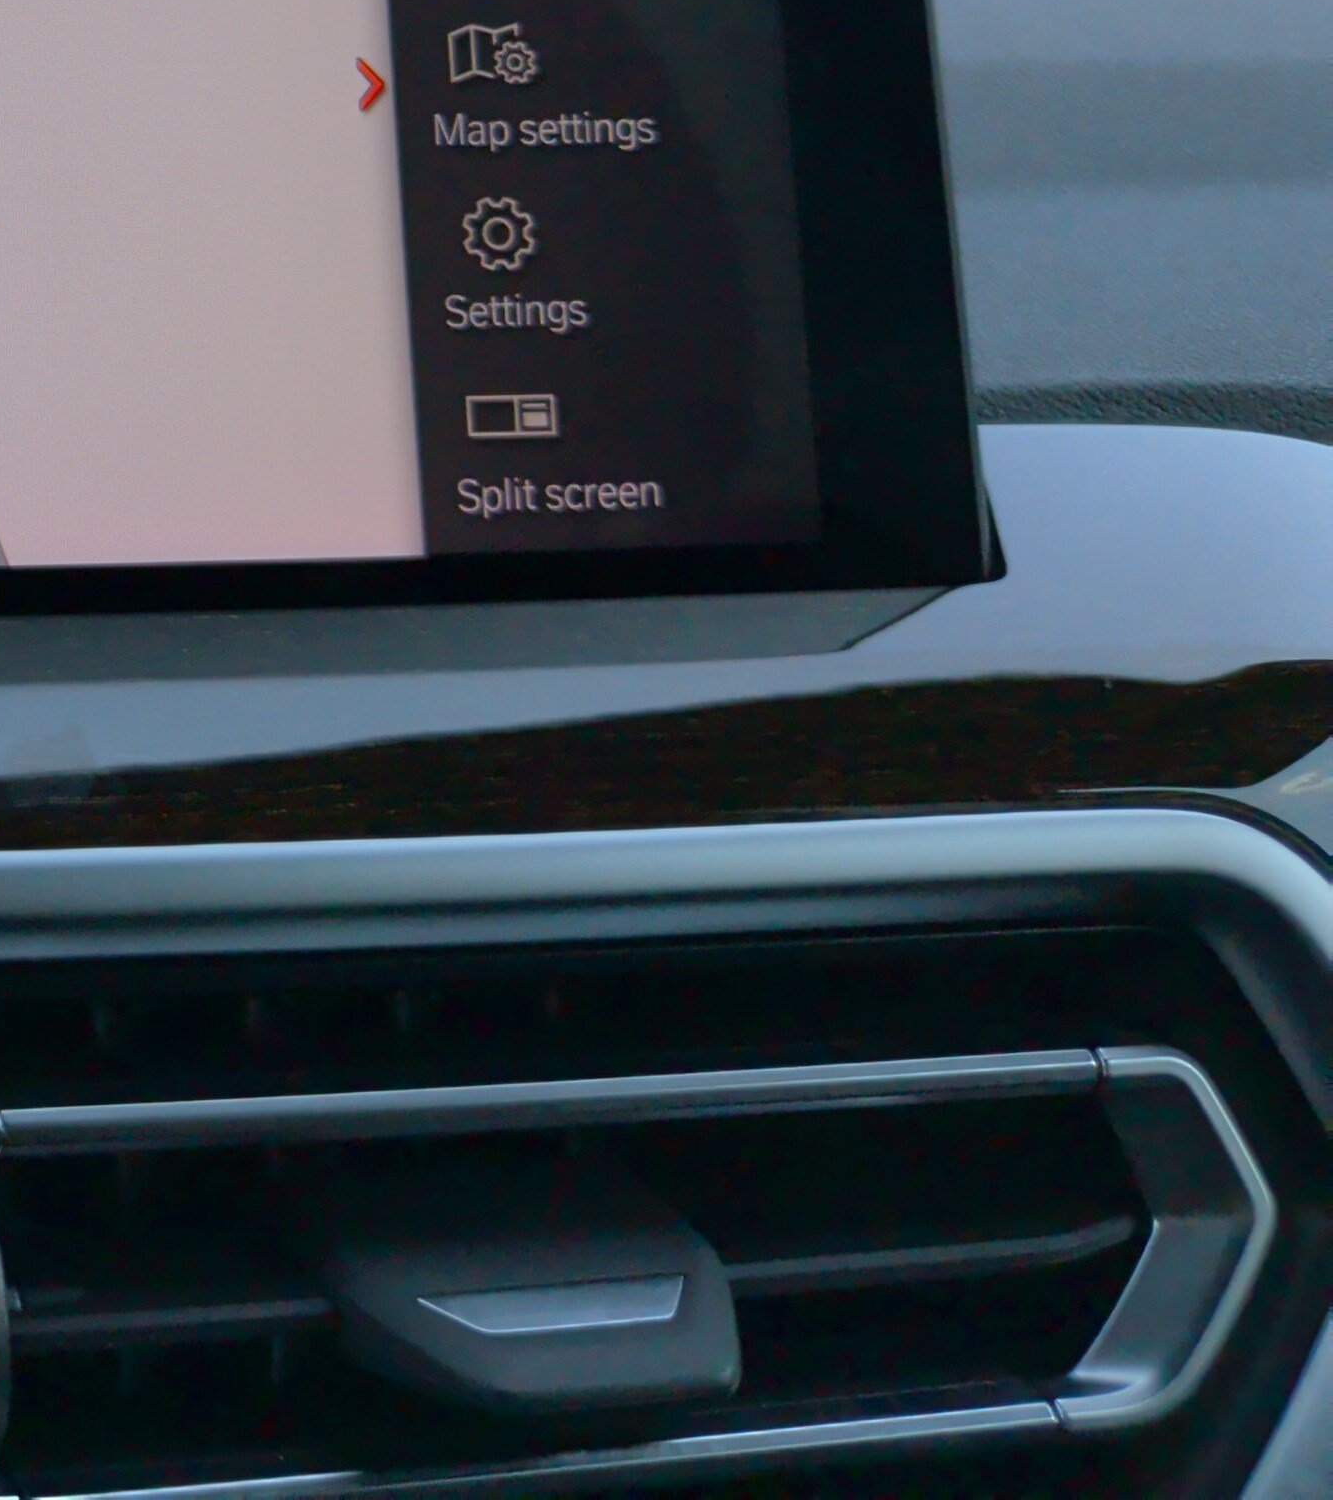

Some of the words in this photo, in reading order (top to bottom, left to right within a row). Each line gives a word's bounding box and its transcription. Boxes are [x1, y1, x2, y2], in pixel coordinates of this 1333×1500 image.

[433, 113, 512, 151] Map
[519, 111, 661, 151] settings
[444, 293, 591, 332] Settings
[456, 476, 537, 517] Split
[545, 479, 664, 509] screen
